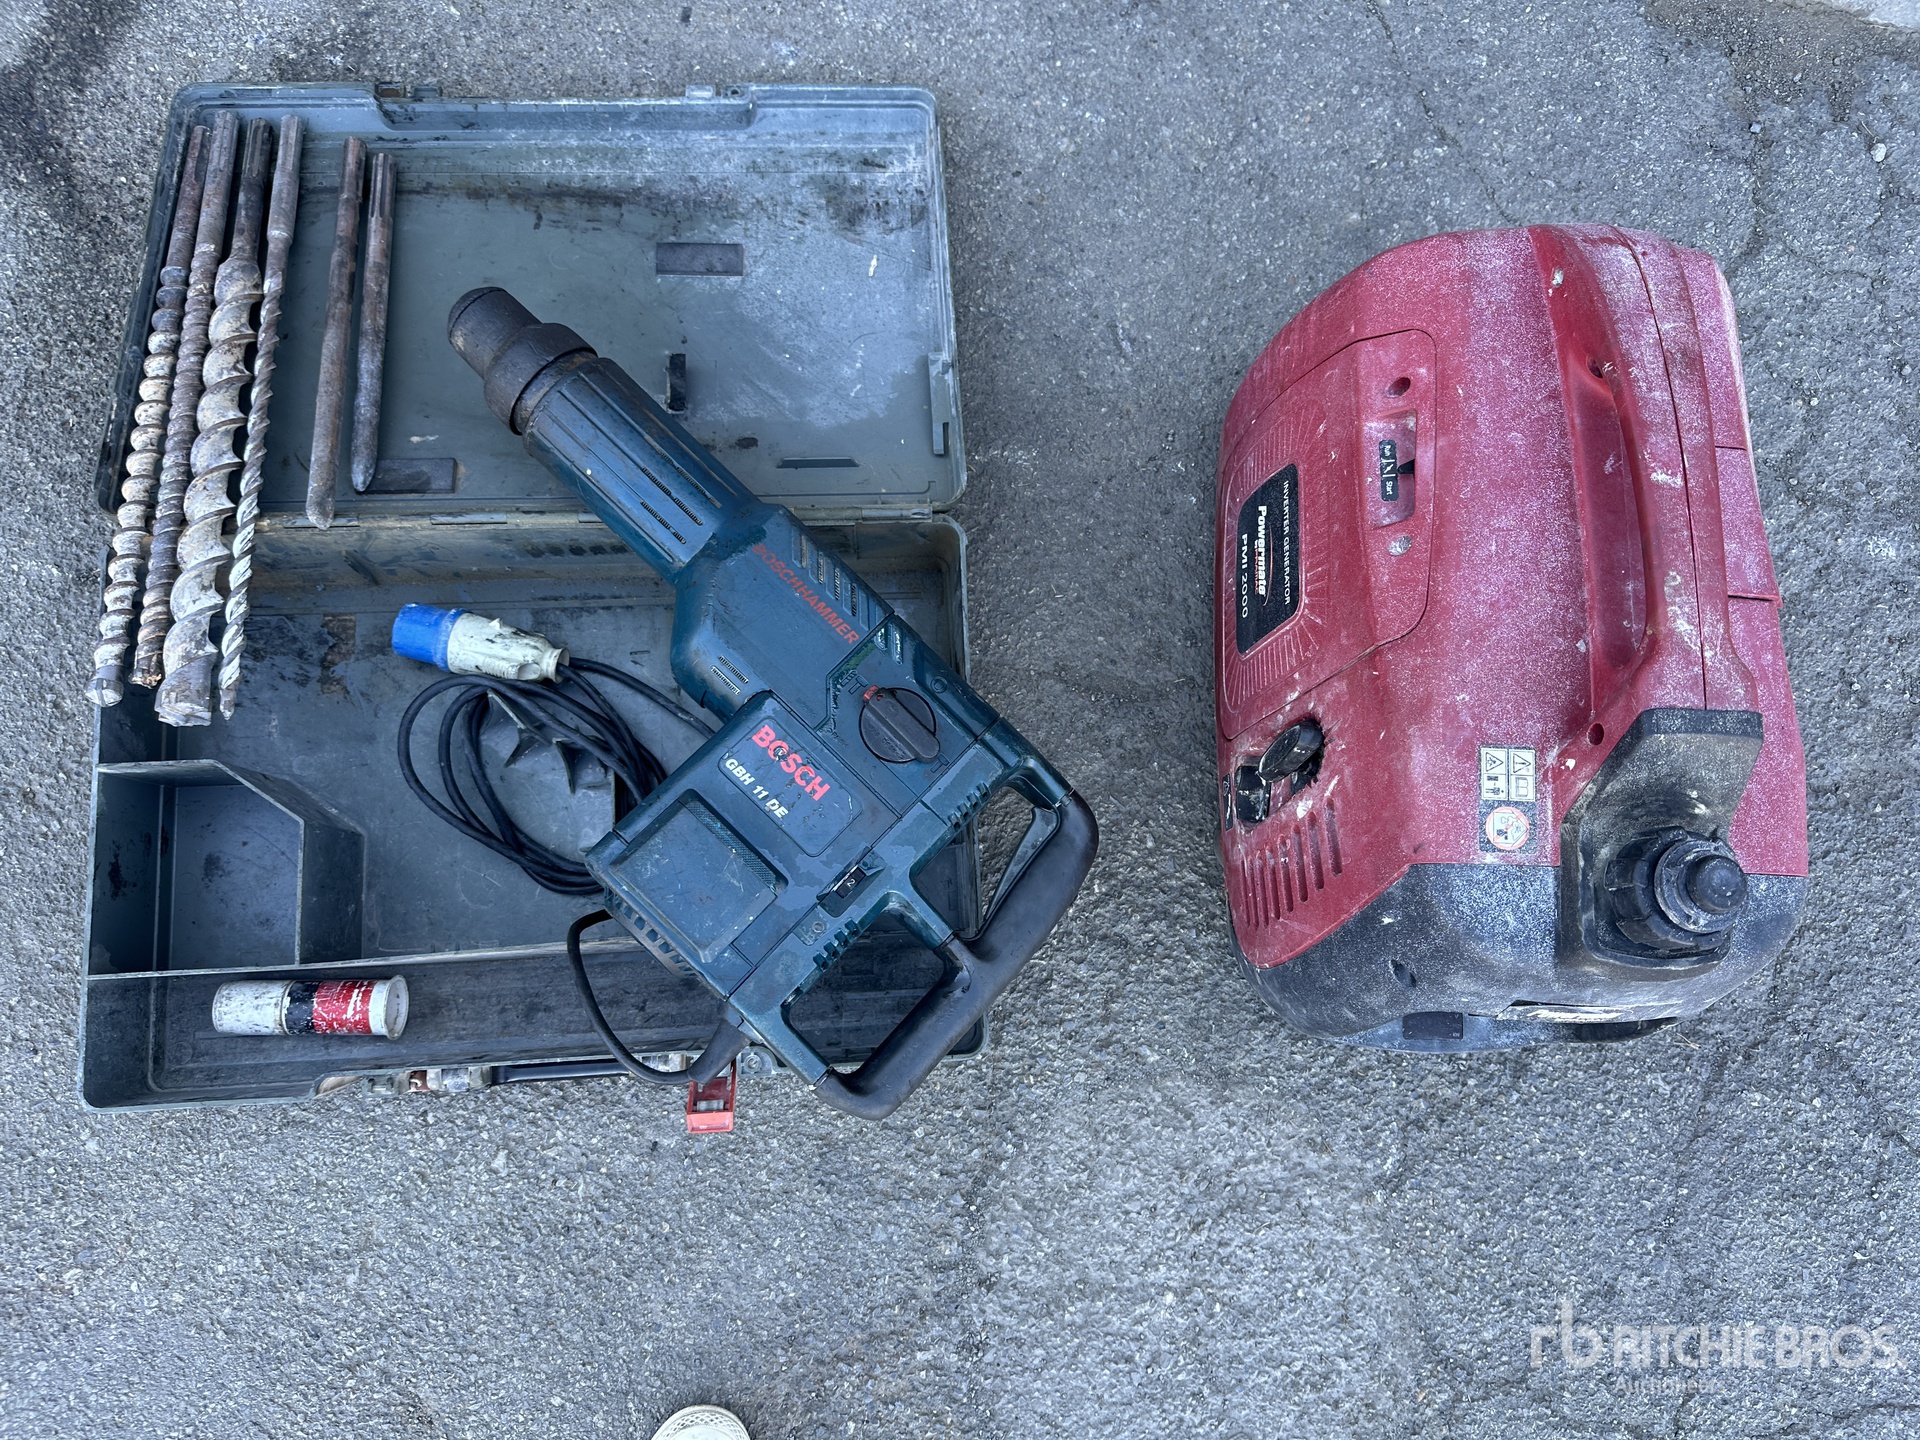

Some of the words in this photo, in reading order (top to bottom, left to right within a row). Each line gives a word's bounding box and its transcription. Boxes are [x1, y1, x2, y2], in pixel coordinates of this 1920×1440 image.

[1385, 480, 1393, 495] Start
[1257, 505, 1267, 596] Powermate
[752, 543, 859, 644] BOSCHHAMMER
[725, 759, 755, 785] GBH
[753, 785, 769, 800] 11
[765, 799, 789, 818] DE
[752, 724, 831, 801] BOSCH
[846, 878, 856, 888] 2
